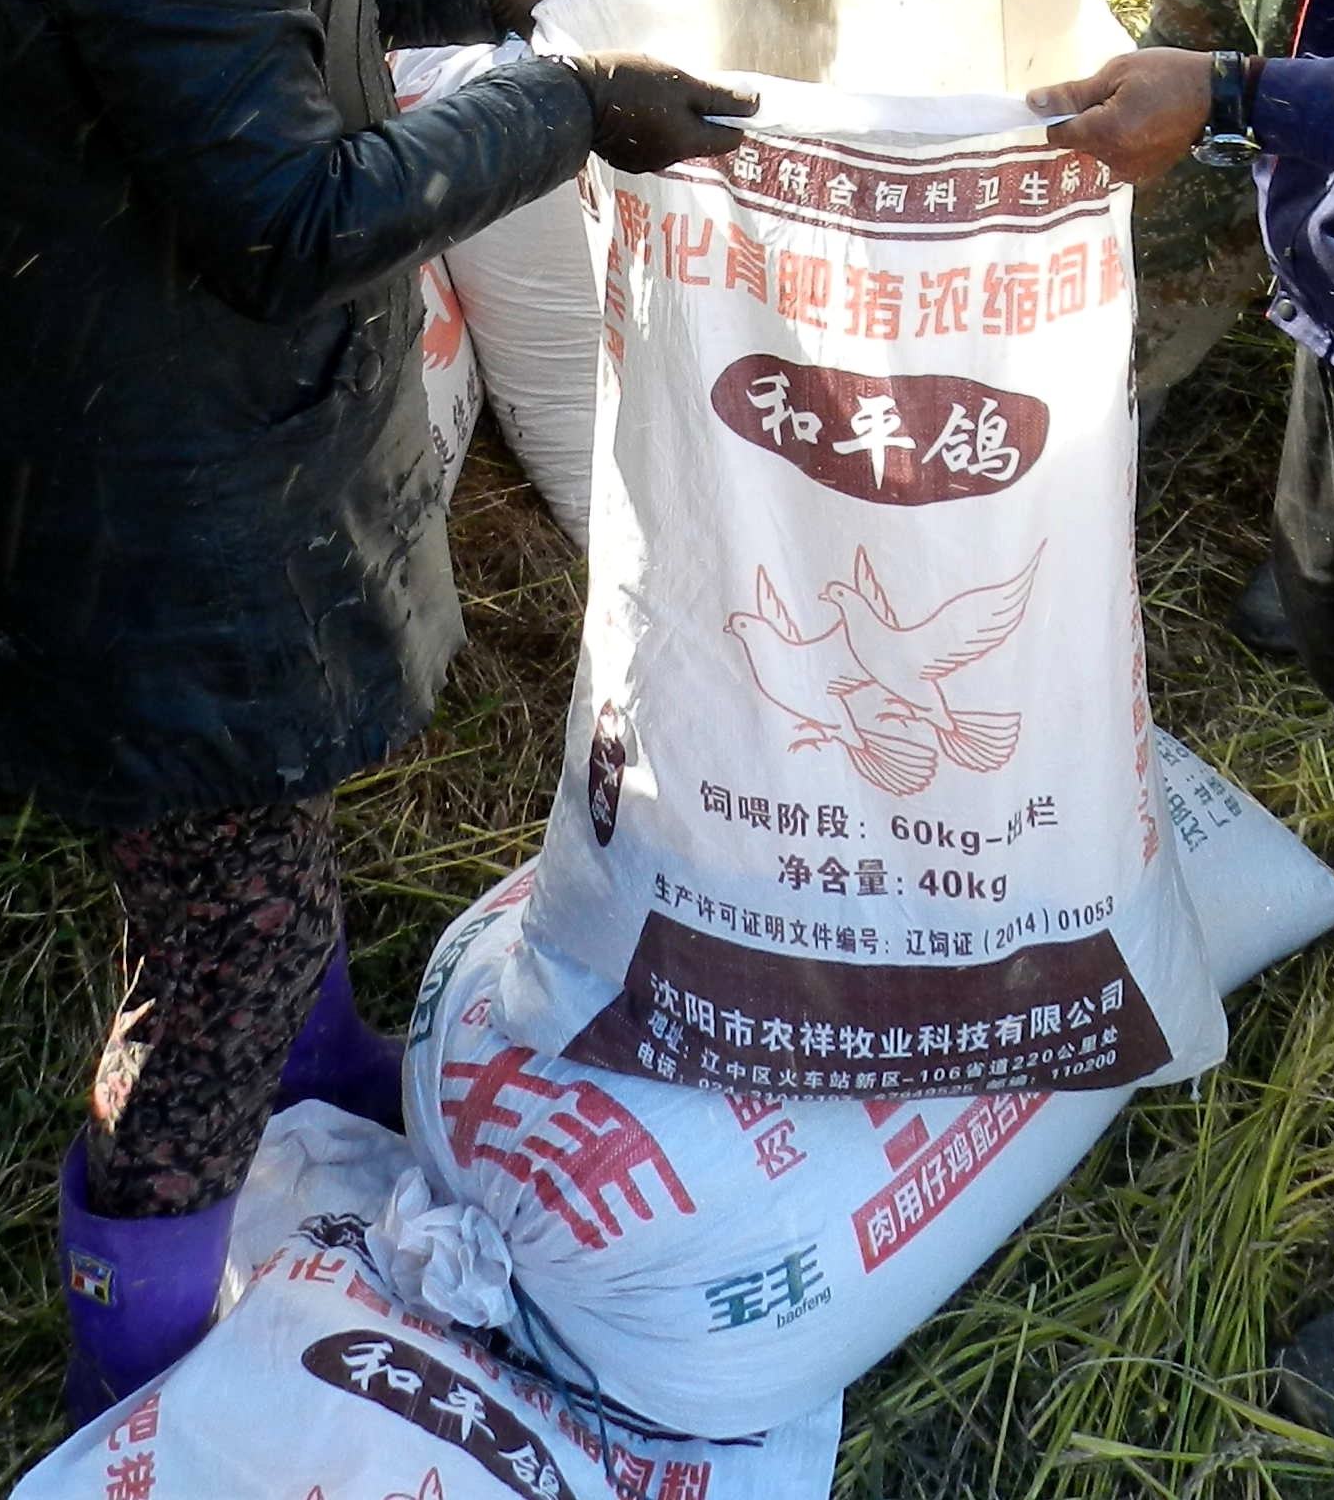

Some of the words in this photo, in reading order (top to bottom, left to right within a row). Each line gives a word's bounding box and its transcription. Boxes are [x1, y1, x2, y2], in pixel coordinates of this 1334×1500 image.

[746, 371, 1020, 490] 和平鸽
[650, 972, 1125, 1060] 沈阳市农祥牧业科技有限公司
[776, 1286, 832, 1329] baofeng
